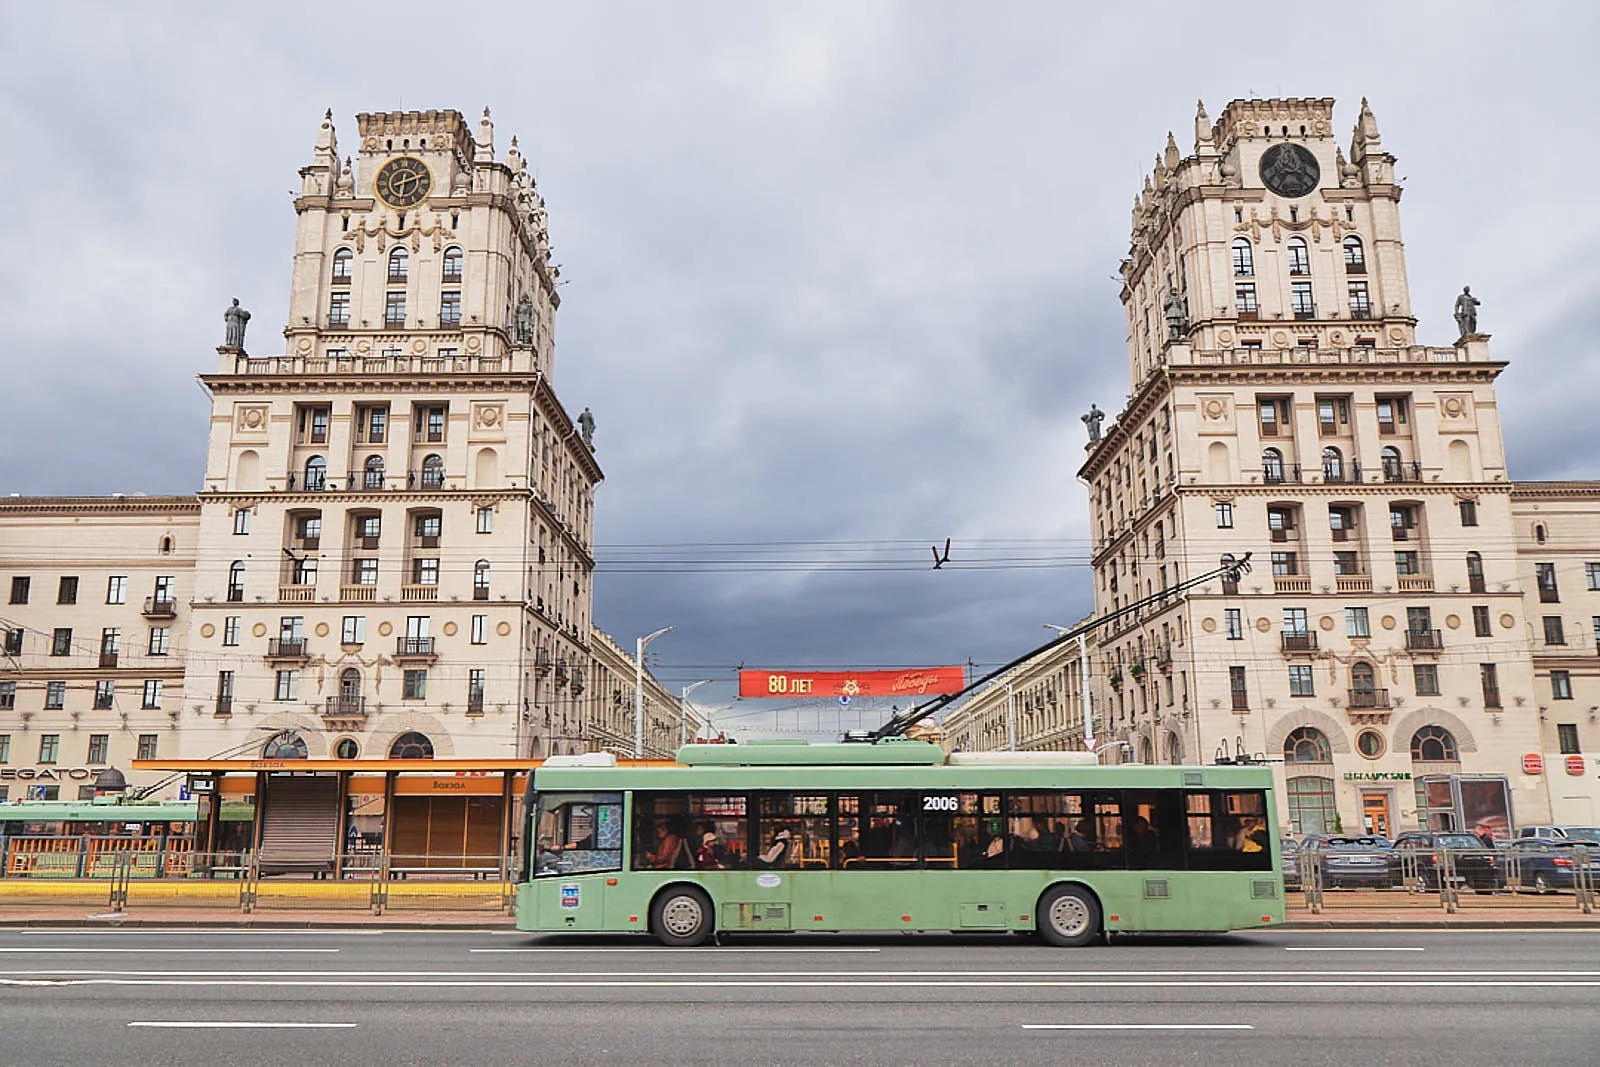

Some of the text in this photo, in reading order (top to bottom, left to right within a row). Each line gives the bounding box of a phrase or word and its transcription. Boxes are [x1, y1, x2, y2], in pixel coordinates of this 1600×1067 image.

[768, 675, 813, 693] 80 ЛЕТ
[923, 797, 958, 810] 2006
